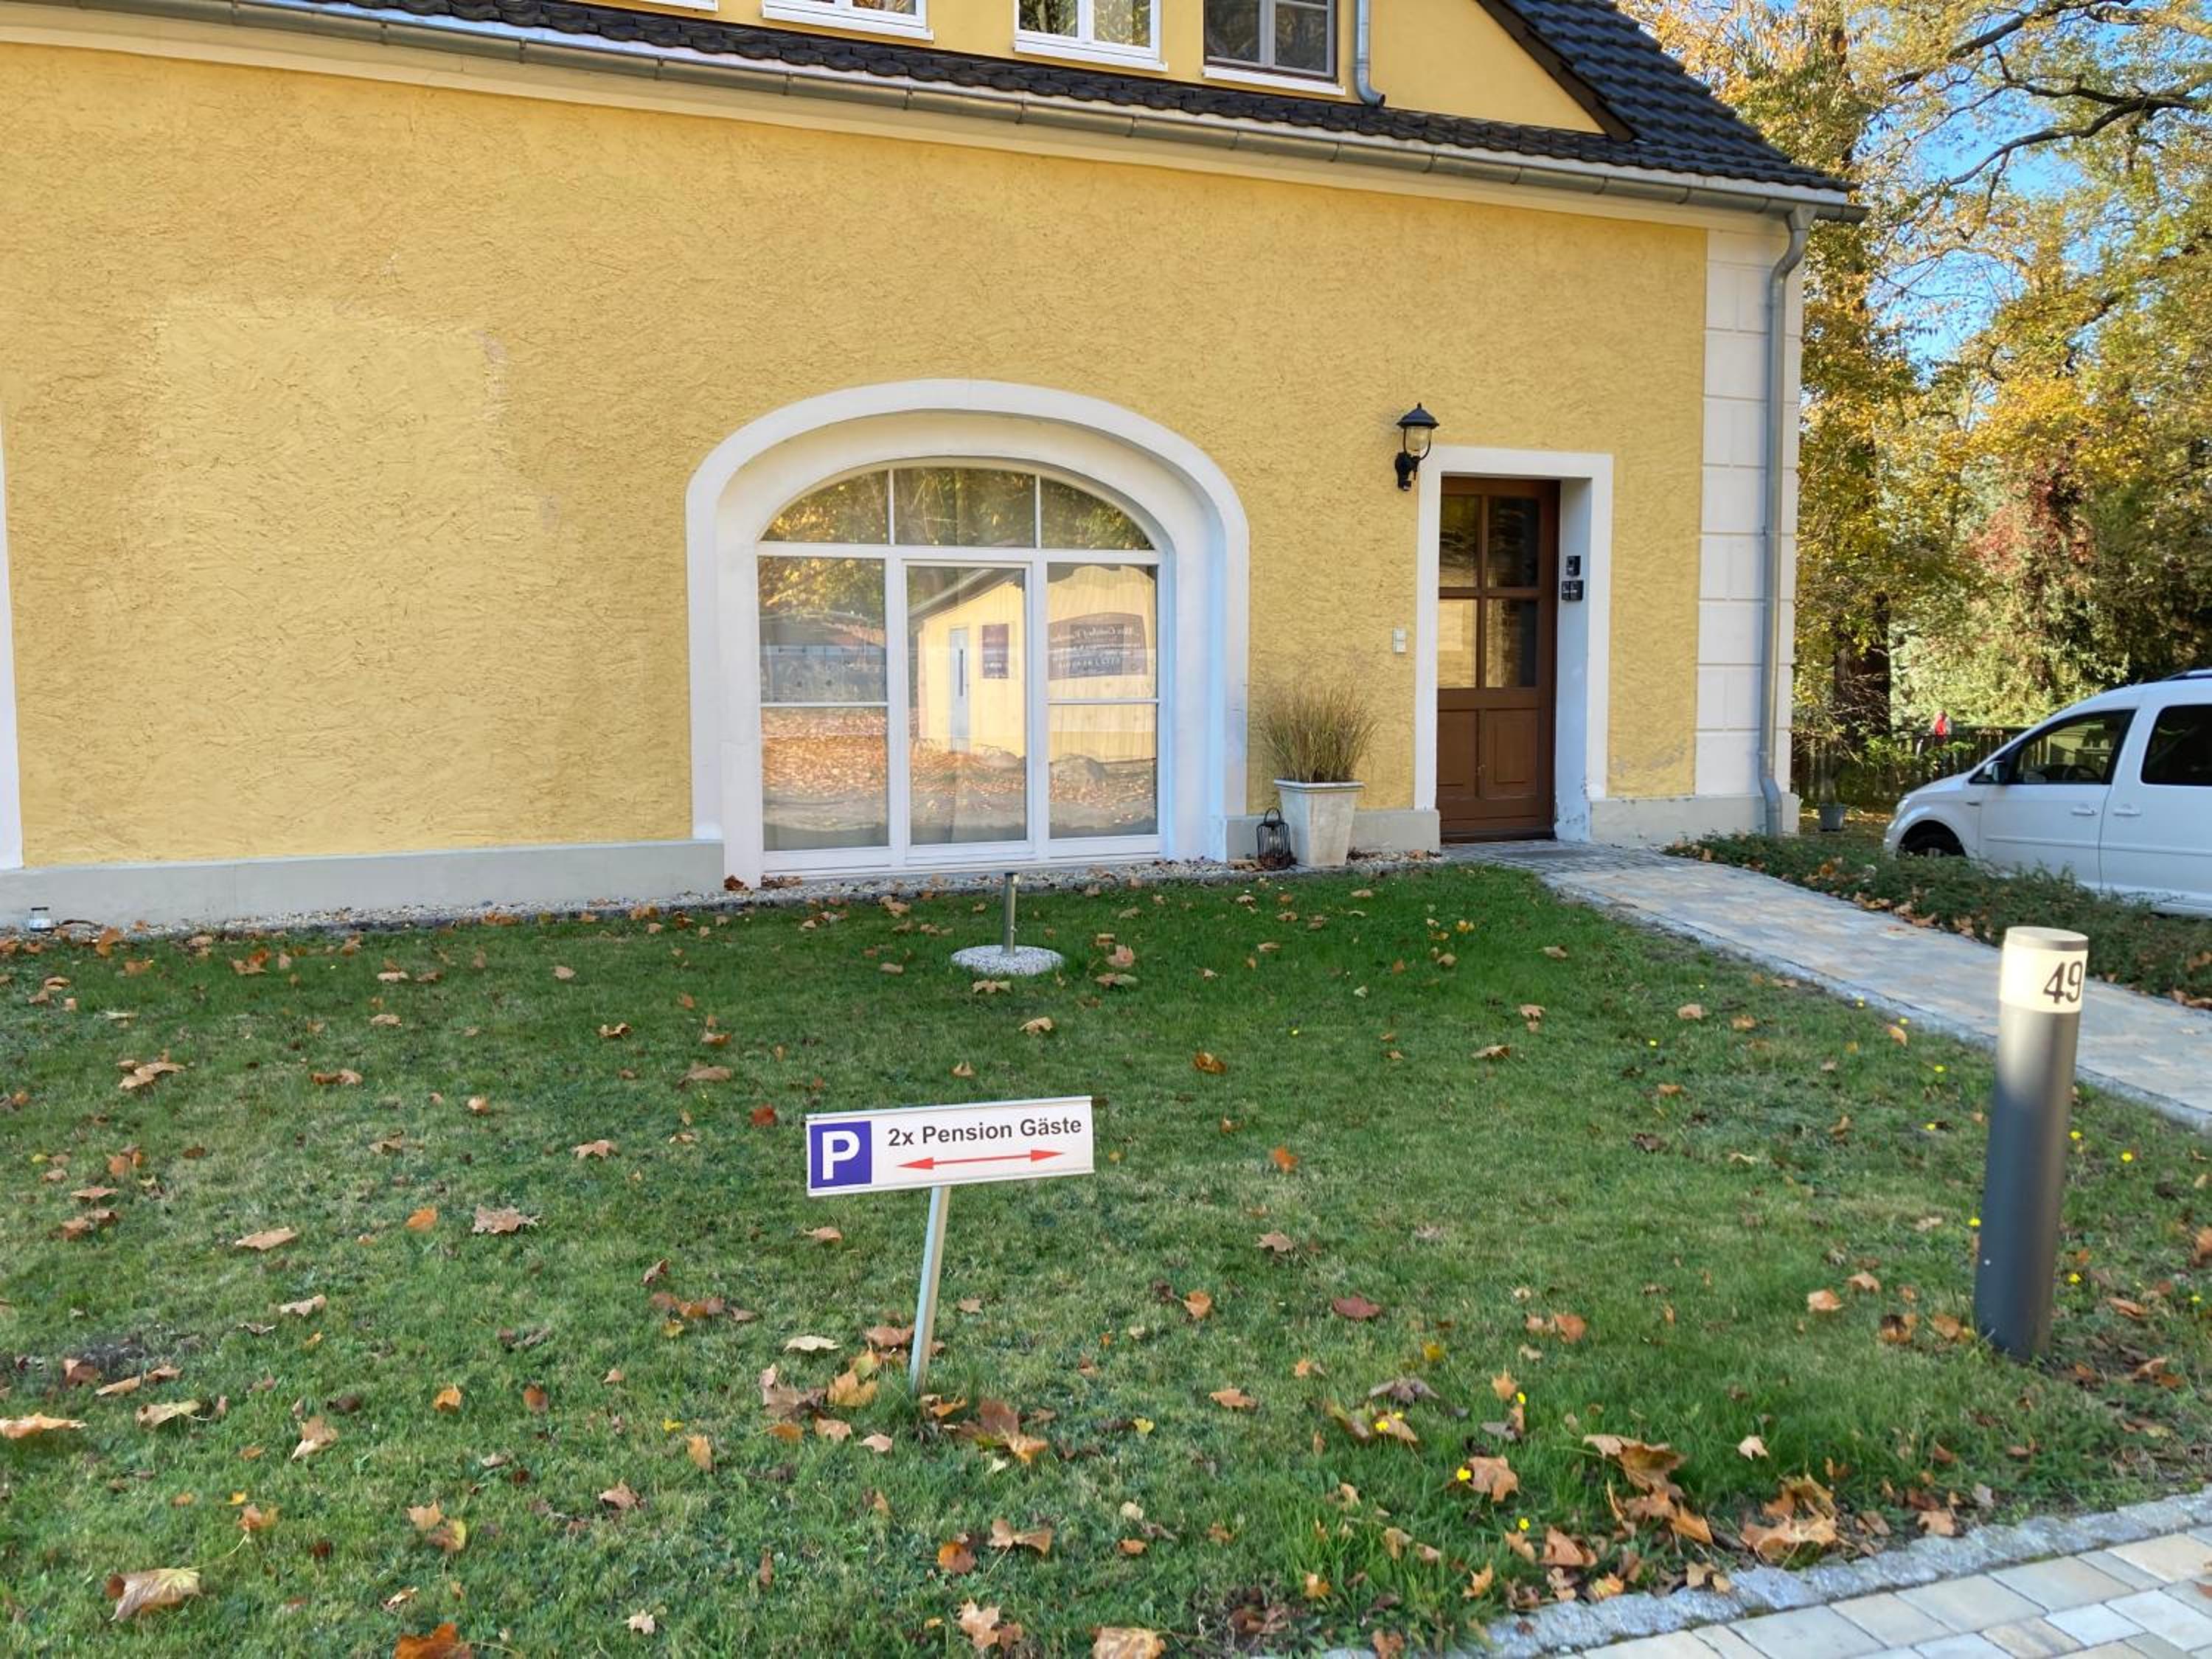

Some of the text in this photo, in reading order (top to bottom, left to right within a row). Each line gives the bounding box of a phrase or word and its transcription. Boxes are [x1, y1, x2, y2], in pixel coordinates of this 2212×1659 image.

[2043, 961, 2083, 1004] 49
[888, 1117, 1082, 1147] 2x Pension Gäste
[822, 1130, 860, 1180] P
